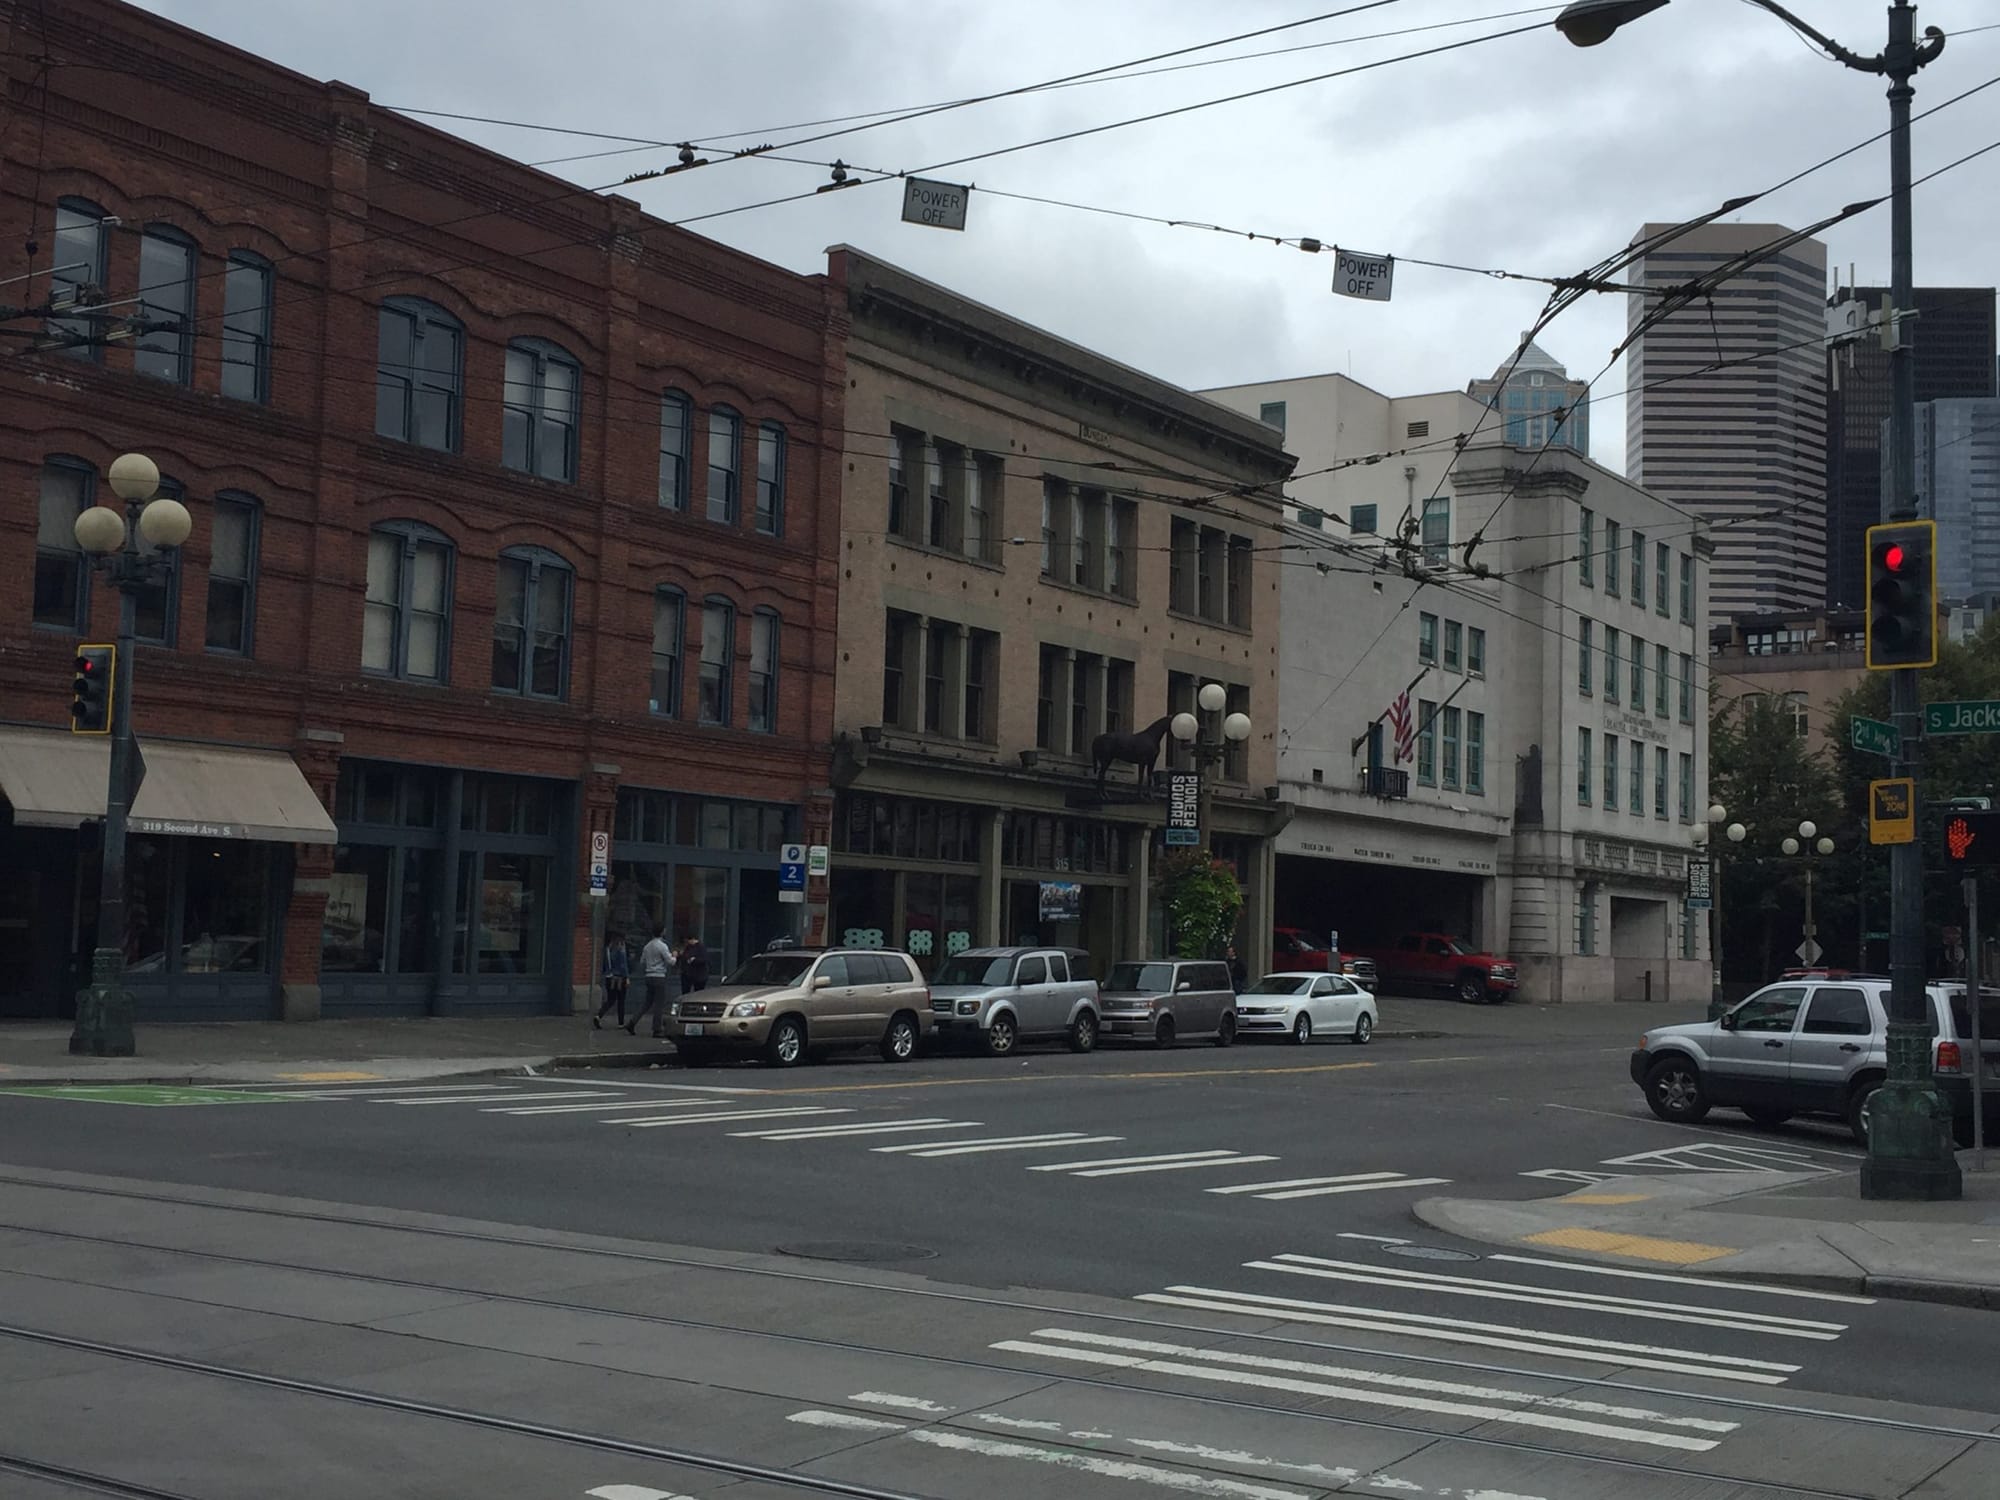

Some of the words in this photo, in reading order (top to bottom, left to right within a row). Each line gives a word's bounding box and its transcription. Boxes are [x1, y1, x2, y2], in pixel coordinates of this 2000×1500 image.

[911, 188, 960, 208] POWER
[922, 207, 946, 223] OFF
[1338, 257, 1388, 279] POWER
[1347, 278, 1375, 296] OFF
[1930, 711, 1942, 728] S
[1170, 775, 1185, 827] SQUARE
[1183, 775, 1198, 828] PIONEER
[143, 822, 162, 831] 319
[163, 822, 198, 834] Second
[200, 825, 218, 835] Ave
[787, 866, 797, 879] 2
[843, 928, 884, 948] 88
[908, 929, 933, 949] 88
[947, 931, 970, 951] 88
